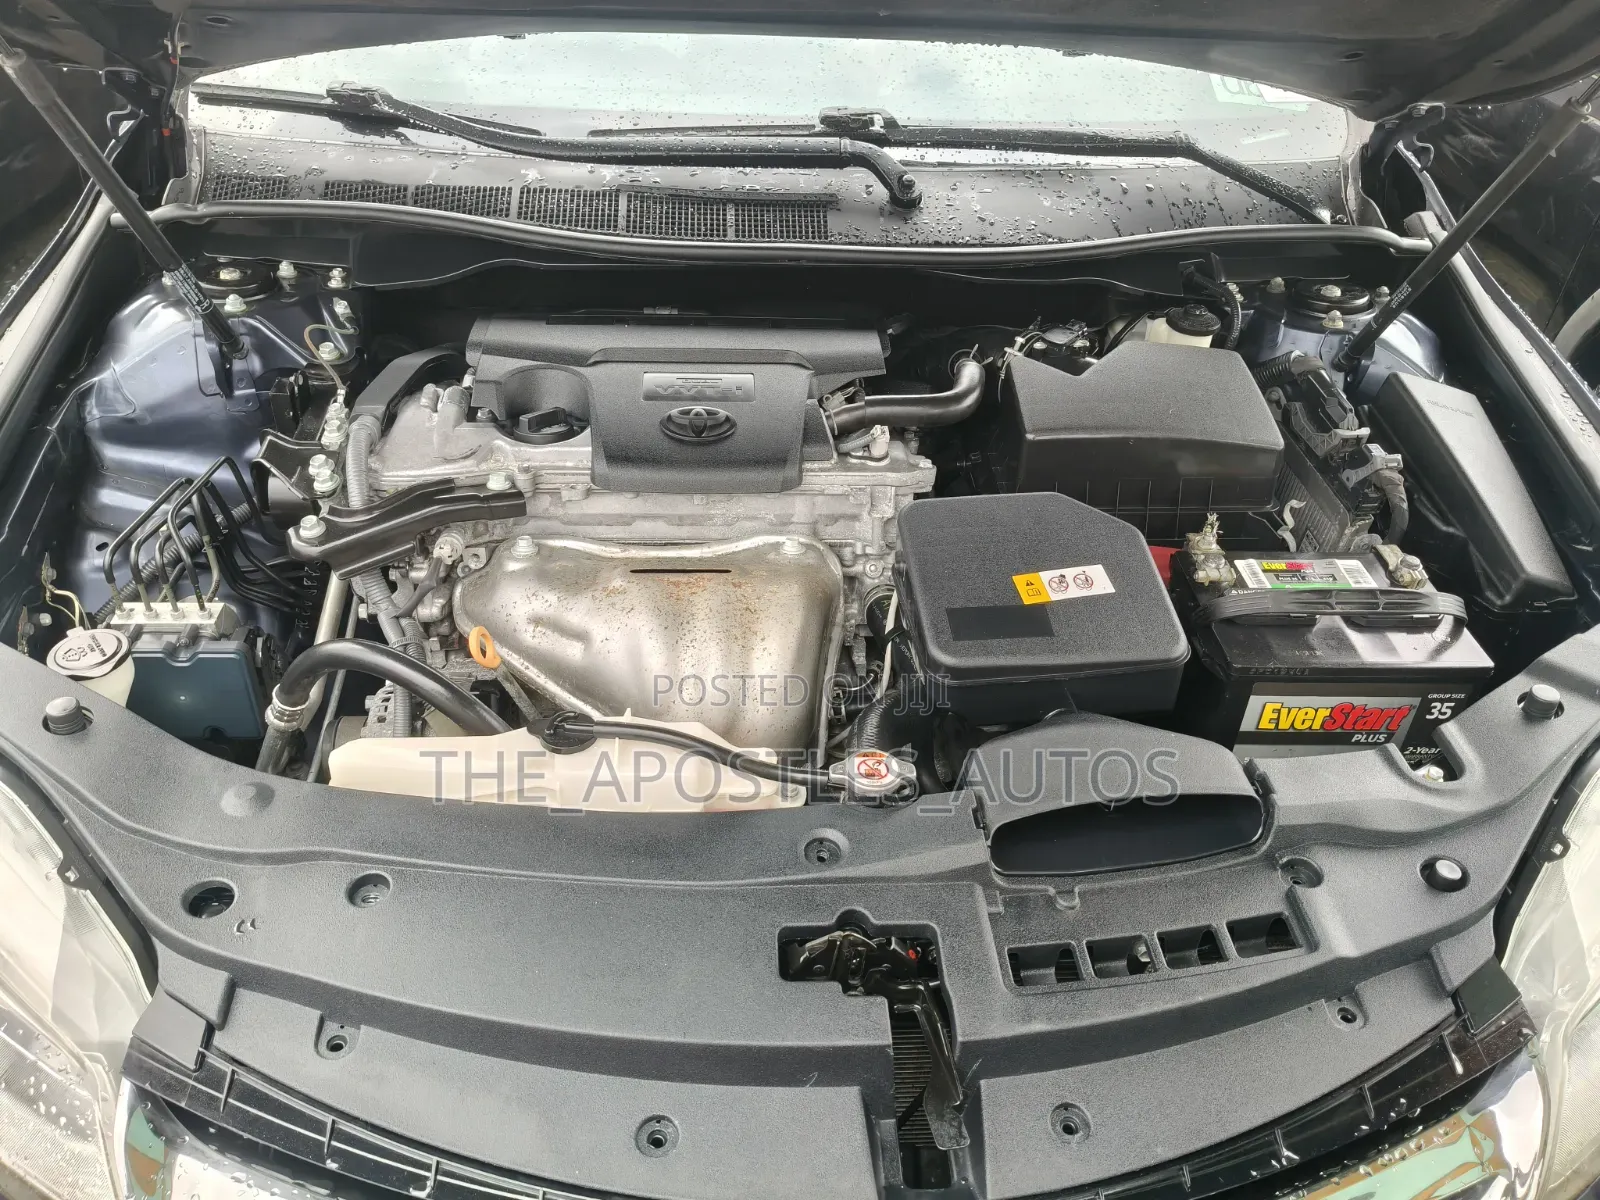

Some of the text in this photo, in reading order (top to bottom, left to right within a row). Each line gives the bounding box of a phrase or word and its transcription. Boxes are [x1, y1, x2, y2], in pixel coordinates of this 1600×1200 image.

[1256, 702, 1411, 731] EverStart
[1425, 702, 1456, 719] 35
[1351, 734, 1387, 743] PLUS
[1403, 746, 1441, 754] 2-Year
